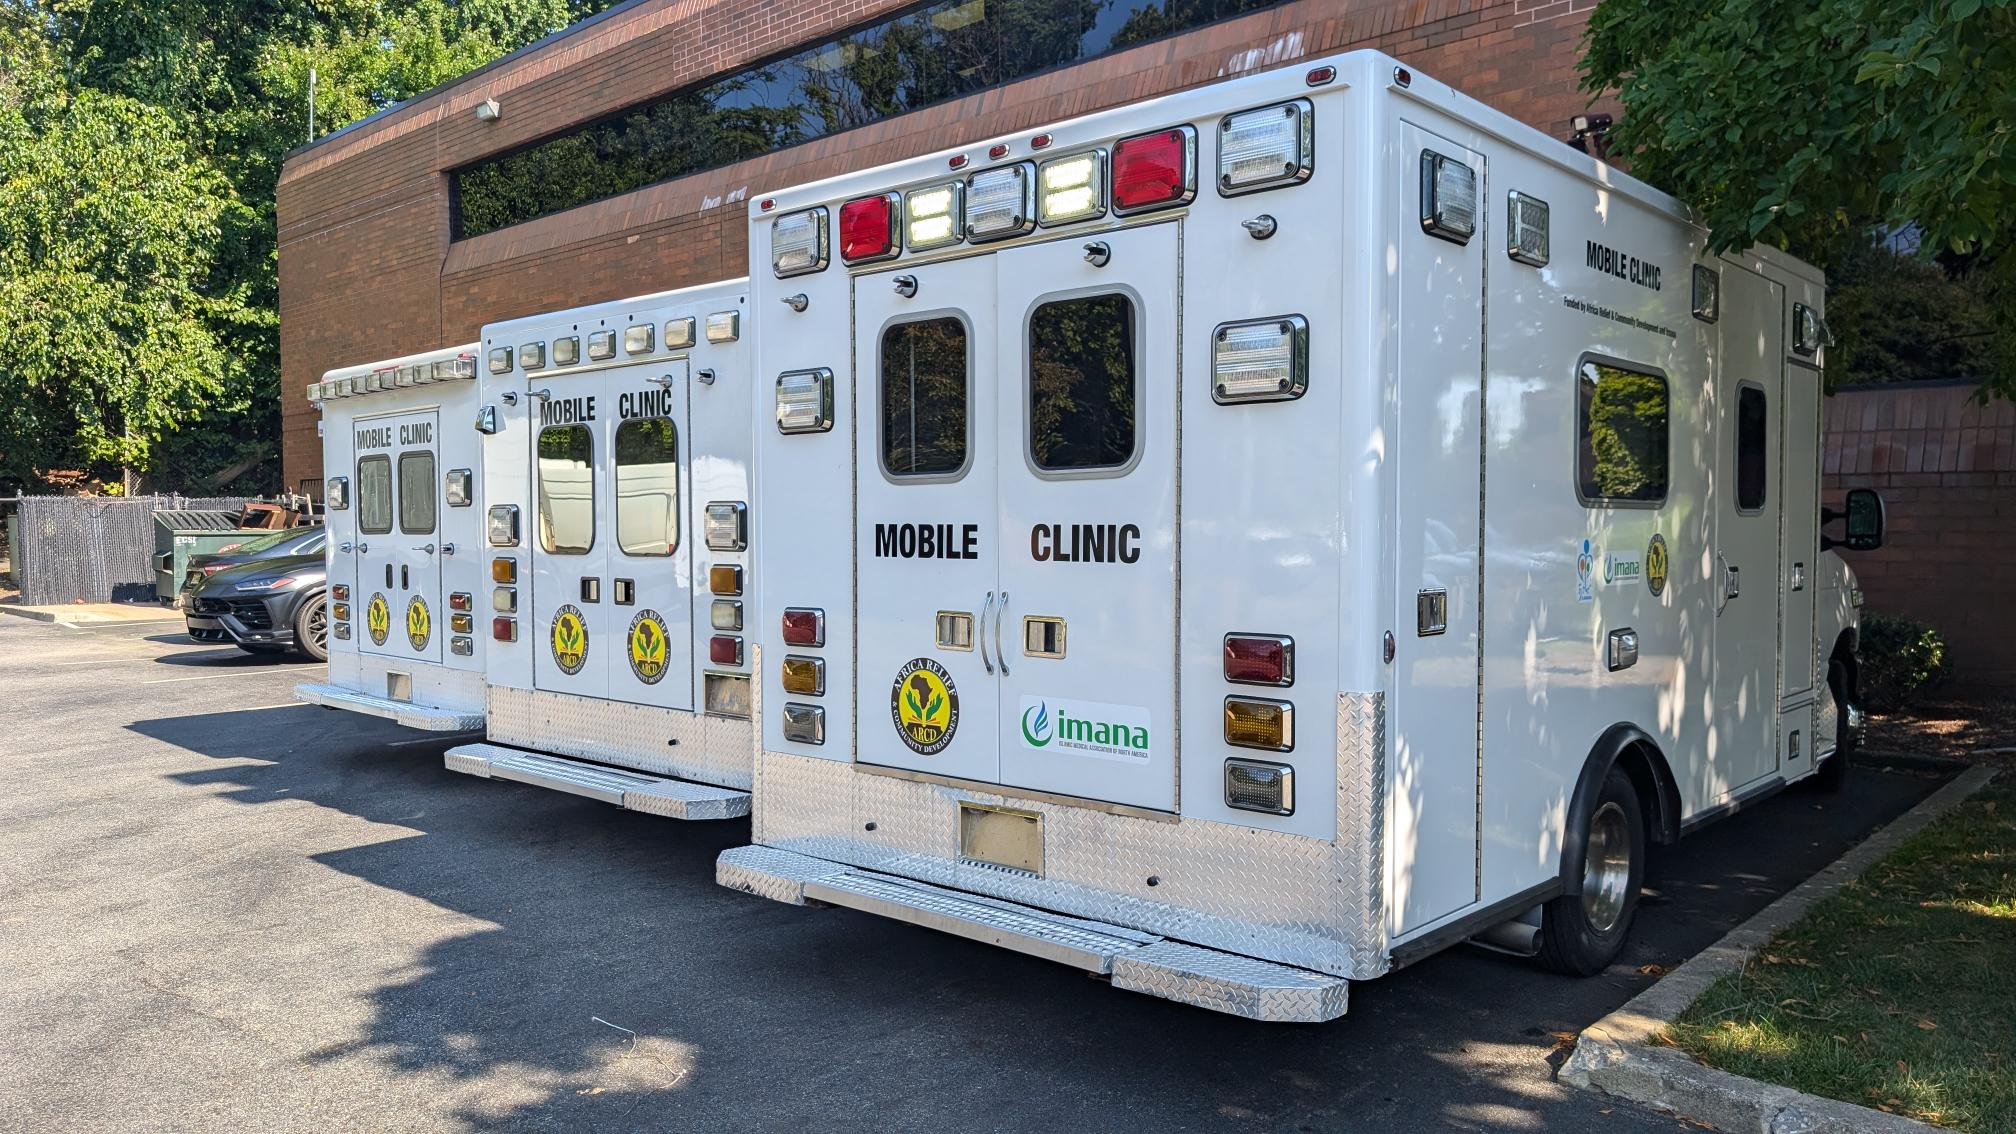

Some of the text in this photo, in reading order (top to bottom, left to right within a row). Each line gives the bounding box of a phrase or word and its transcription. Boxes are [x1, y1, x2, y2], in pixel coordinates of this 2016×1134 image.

[1587, 240, 1661, 291] MOBILE CLINIC
[540, 388, 673, 426] MOBILE CLINIC
[356, 422, 433, 450] MOBILE CLINIC
[875, 523, 1142, 564] MOBILE CLINIC
[1614, 557, 1640, 576] imana
[893, 659, 957, 697] AFRICA RELIEF
[892, 700, 958, 753] & COMMUNITY DEVELOPMENT
[911, 726, 937, 742] ARCD
[1058, 709, 1149, 750] imana
[1131, 750, 1149, 759] AMERICA
